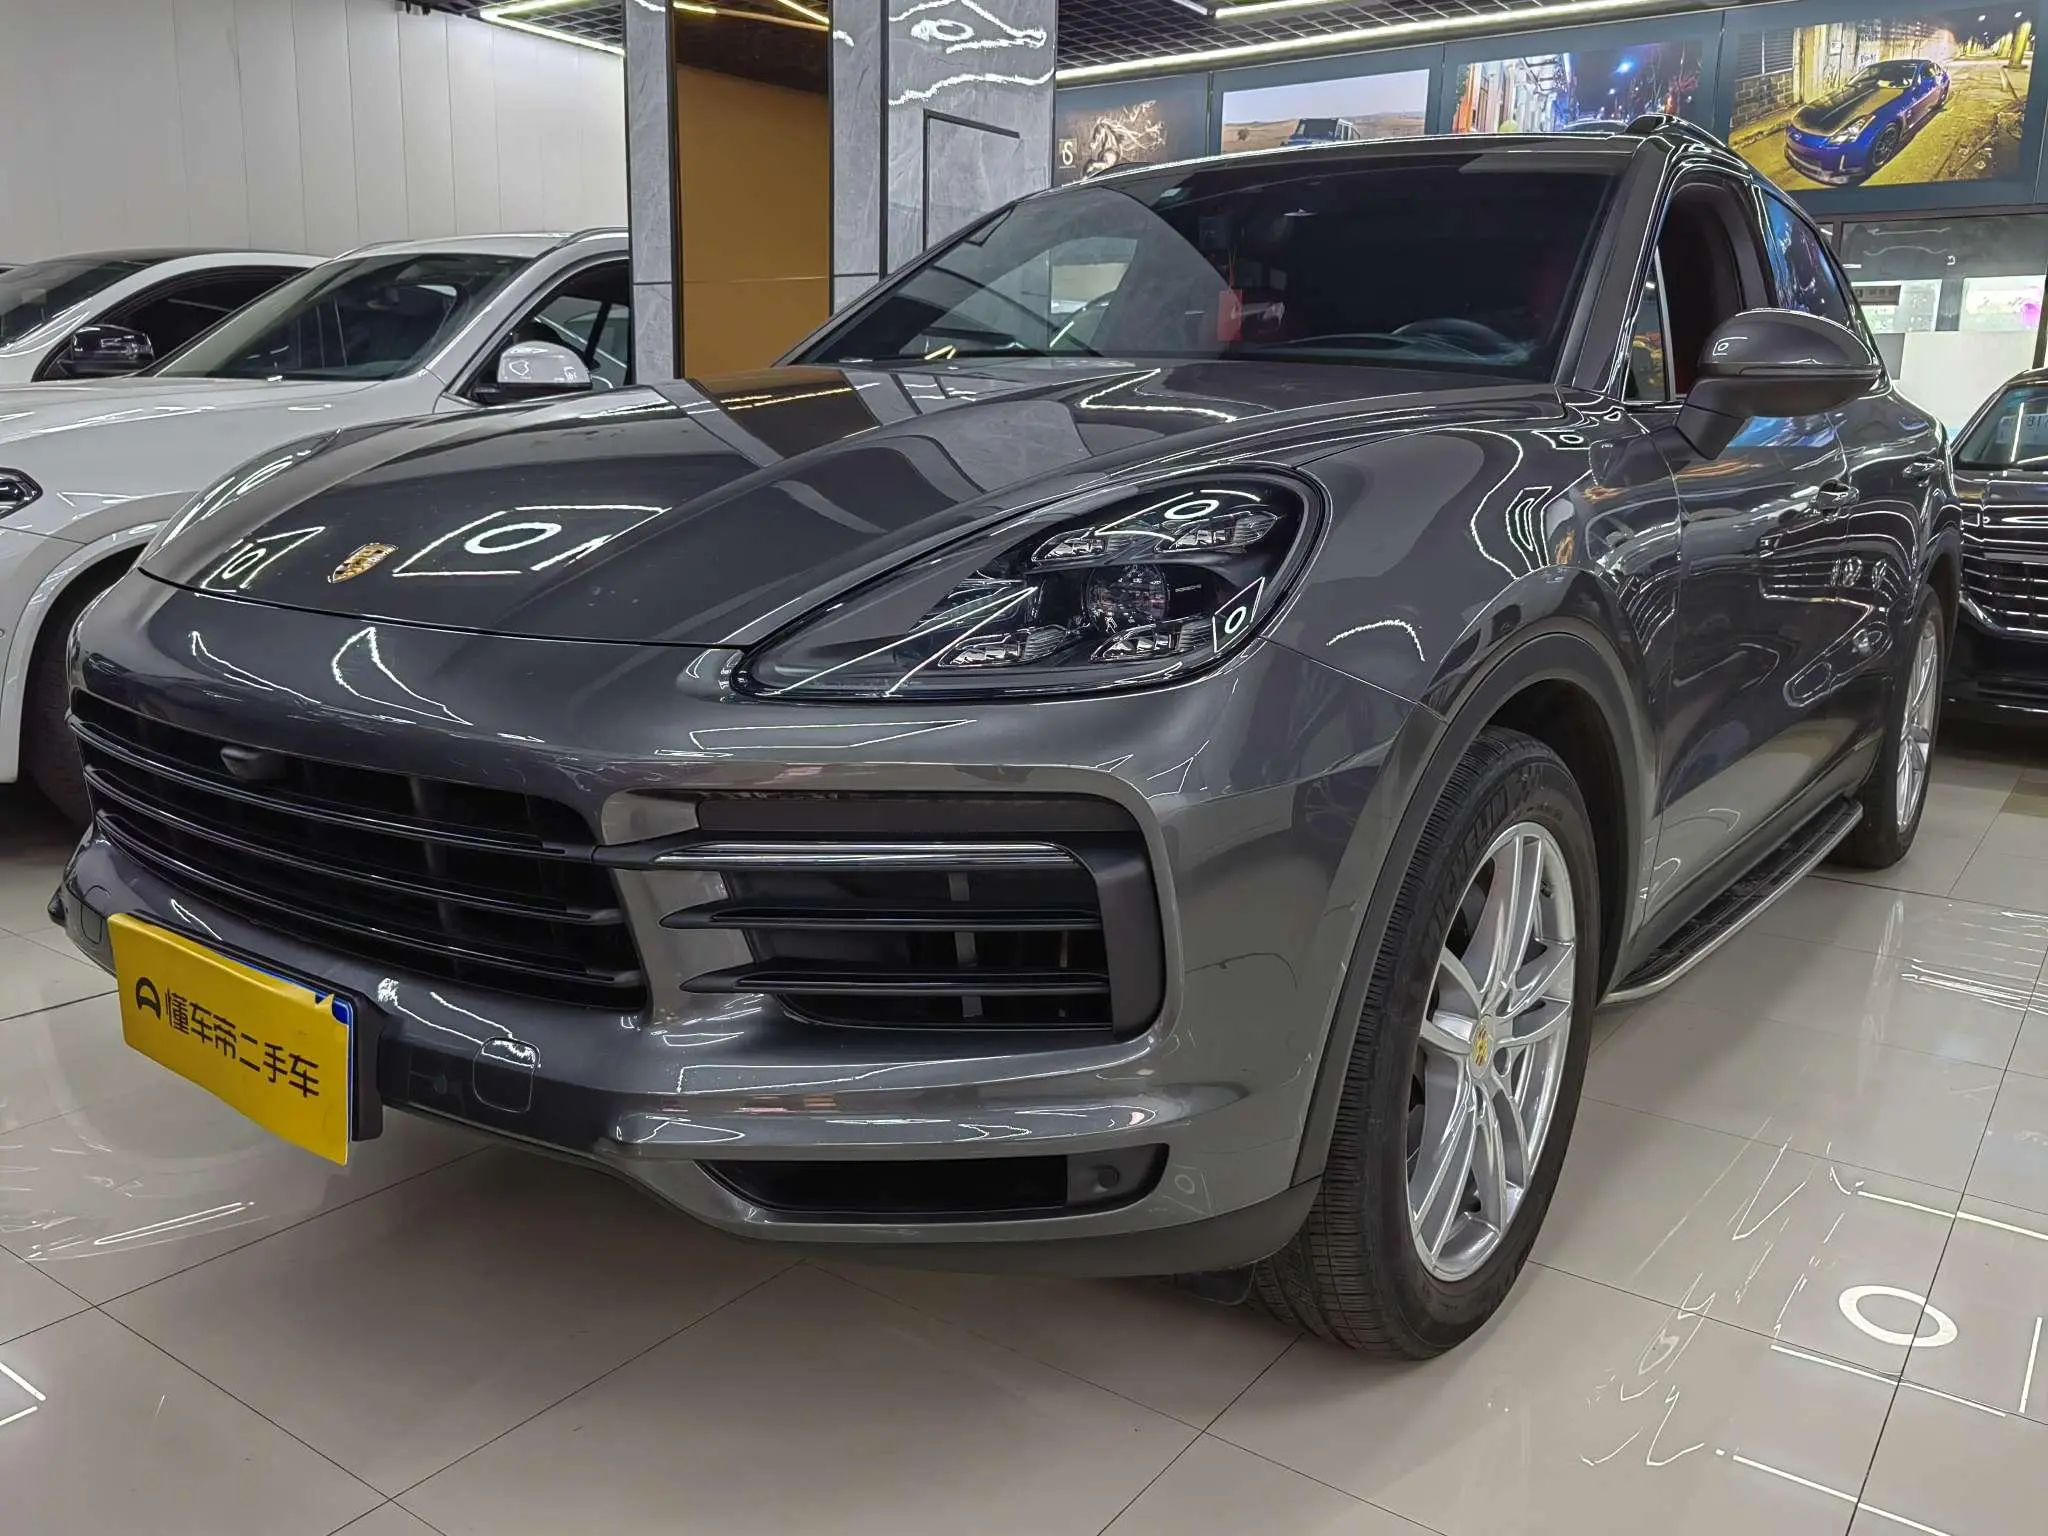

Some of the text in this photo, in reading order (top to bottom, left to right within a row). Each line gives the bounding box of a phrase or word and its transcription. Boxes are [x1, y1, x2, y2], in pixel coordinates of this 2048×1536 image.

[166, 988, 319, 1098] 懂车帝二手车
